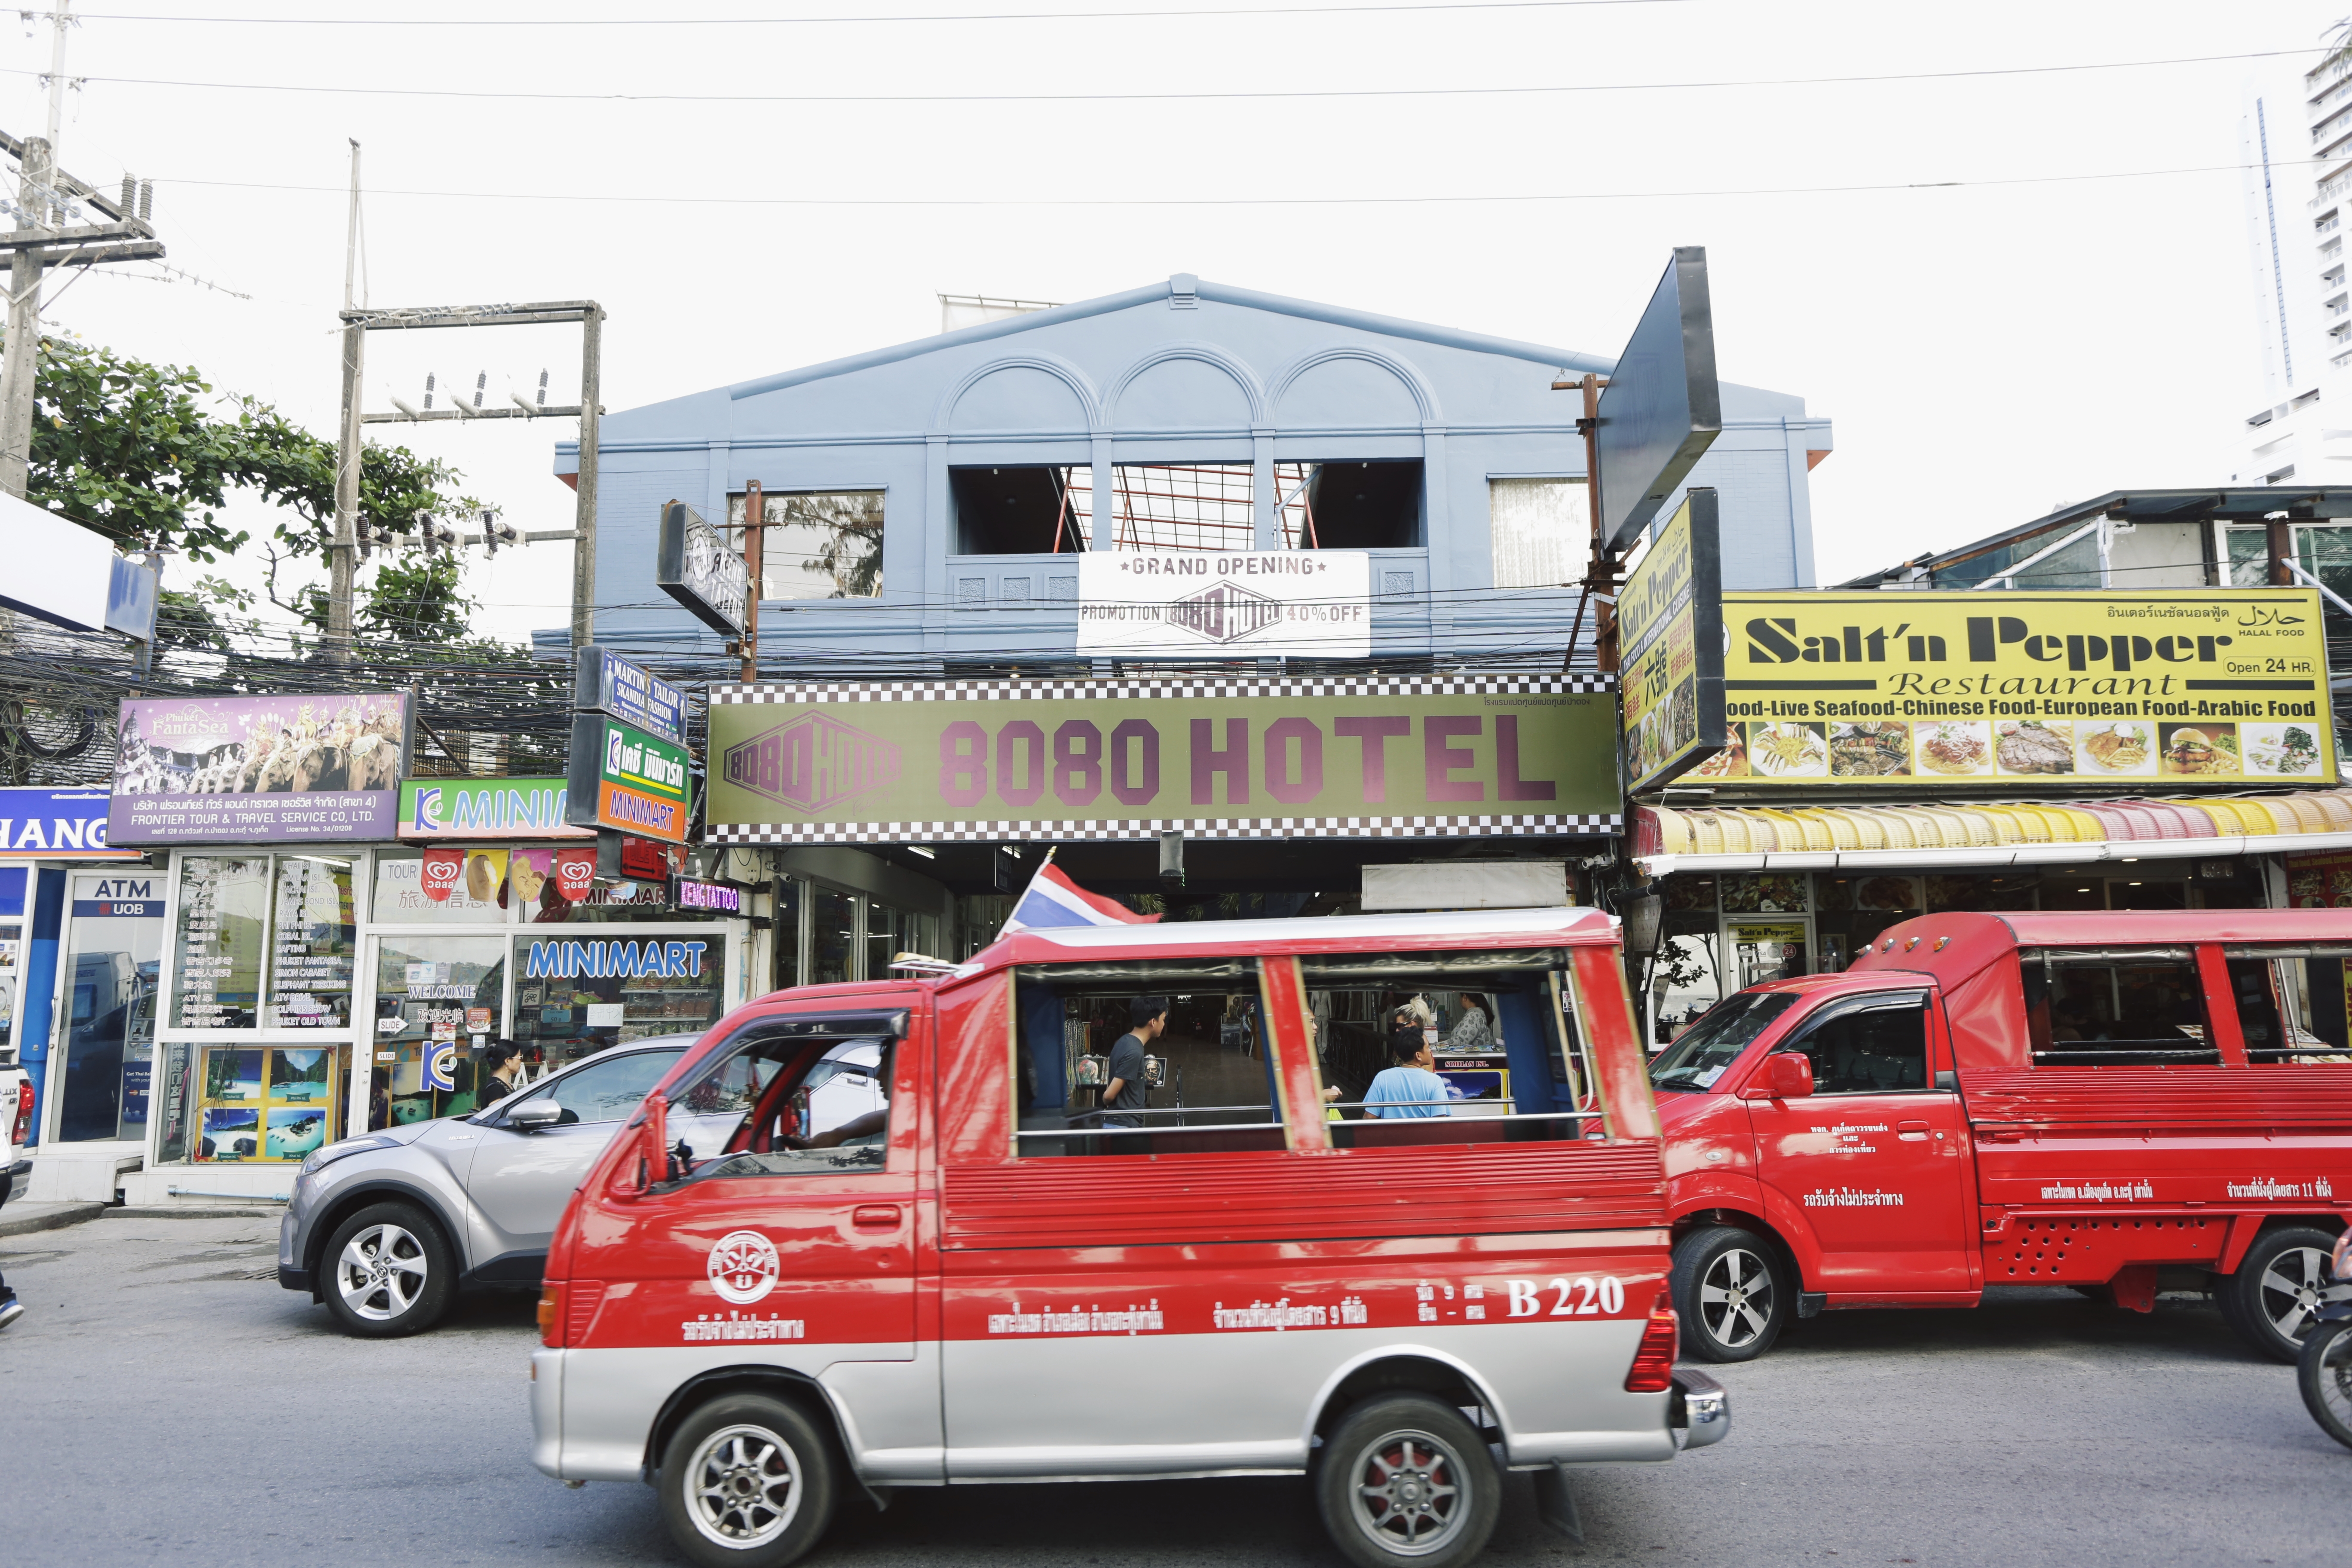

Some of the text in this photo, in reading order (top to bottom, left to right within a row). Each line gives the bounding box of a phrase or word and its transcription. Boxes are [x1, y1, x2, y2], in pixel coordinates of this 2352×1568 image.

[719, 547, 742, 588] KENG
[1133, 557, 1313, 575] GRAND OPENING
[1648, 543, 1687, 616] Pepper
[710, 577, 743, 625] TATTOO
[1082, 605, 1160, 620] PROMOTION
[1170, 588, 1223, 638] 8080
[1224, 586, 1279, 641] HOTEL
[1330, 606, 1362, 621] OFF
[2237, 606, 2305, 626] حلال
[1631, 644, 1640, 661] FOOD
[1644, 609, 1672, 652] INTERNATIONAL
[1673, 583, 1690, 615] CUISINE
[1966, 617, 2233, 671] Pepper
[2227, 658, 2314, 674] Open 24 HR.
[614, 660, 678, 709] MARTIN'S TAILOR
[1888, 673, 2178, 695] Restaurant
[617, 683, 672, 721] SKANDIA FASHION
[1626, 692, 1640, 723] 海鮮
[2269, 701, 2315, 716] Food
[166, 713, 198, 722] Phuket
[153, 720, 229, 735] FantaSea
[621, 743, 683, 787] เคซี มินิมาร์ท
[731, 721, 897, 804] 8080 HOTEL
[939, 715, 1556, 807] 8080 HOTEL
[133, 800, 157, 810] บริษัท
[160, 799, 204, 810] ฟรอนเทียร์
[206, 798, 223, 809] ทัวร์
[225, 798, 248, 809] แอนด์
[250, 799, 279, 808] ทราเวล
[282, 797, 312, 808] เซอร์วิส
[314, 796, 336, 807] จำกัด
[365, 795, 376, 808] 4)
[131, 811, 374, 825] FRONTIER TOUR & TRAVEL SERVICE CO, LTD.
[610, 790, 674, 831] MINIMART
[151, 826, 165, 834] เลขที่
[388, 864, 417, 879] TOUR
[95, 880, 150, 897] ATM
[282, 885, 307, 894] TACHAI
[564, 879, 590, 889] วอลล์
[113, 903, 144, 914] UOB
[277, 932, 300, 940] CORAL
[1764, 927, 1794, 938] Pepper
[276, 944, 306, 952] RAFTING
[276, 956, 342, 965] PHUKET FANTASEA
[526, 940, 707, 978] MINIMART
[275, 968, 331, 977] SIMON CABARET
[274, 980, 346, 989] ELEPHANT TREKKING
[407, 985, 476, 998] WELCOME
[290, 993, 310, 1001] DRIVE
[273, 1004, 331, 1013] DOLPHINS SHOW
[417, 1008, 464, 1023] 欢迎光临
[272, 1017, 340, 1026] PHUKET OLD TOWN
[1829, 1141, 1876, 1153] การท่องเที่ยว
[2041, 1179, 2153, 1202] เฉพาะในเขต อ.เมืองภูเก็ต อ.กะทู้ เท่านั้น
[2227, 1176, 2332, 1200] จำนวนที่นั่งผู้โดยสาร 11 ที่นั่ง
[1444, 1285, 1455, 1300] 9
[1504, 1276, 1624, 1317] B 220
[1330, 1305, 1339, 1324] 9
